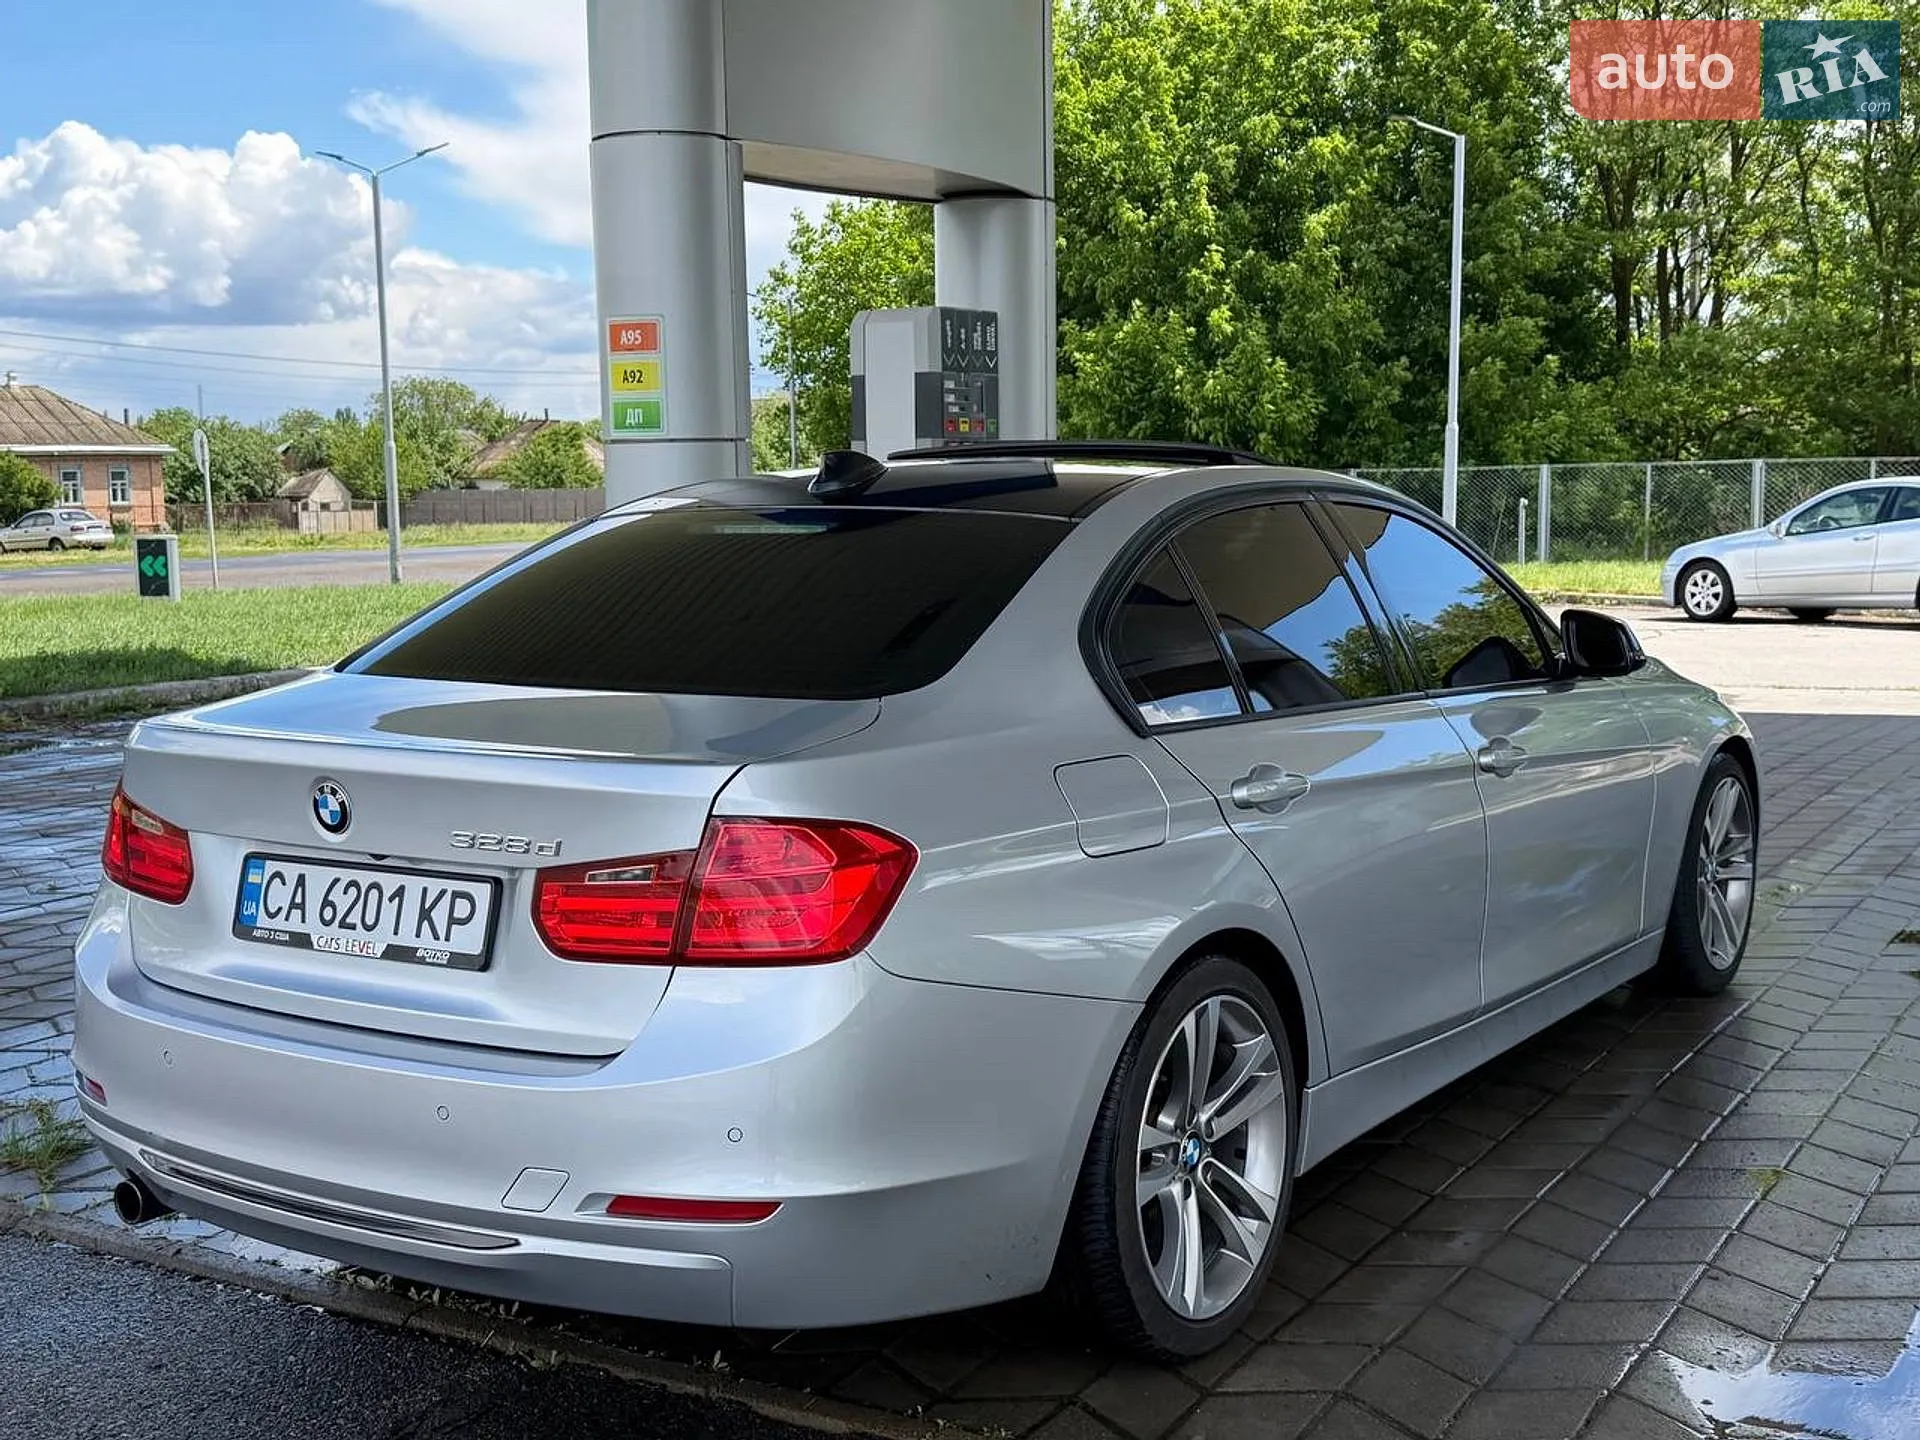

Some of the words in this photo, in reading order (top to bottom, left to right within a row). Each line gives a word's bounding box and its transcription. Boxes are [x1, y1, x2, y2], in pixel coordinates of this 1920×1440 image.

[620, 329, 642, 346] A95
[622, 369, 644, 385] A92
[450, 830, 562, 857] 328d
[242, 899, 258, 916] UA
[262, 870, 307, 924] CA
[318, 876, 407, 936] 6201
[414, 886, 477, 942] KP
